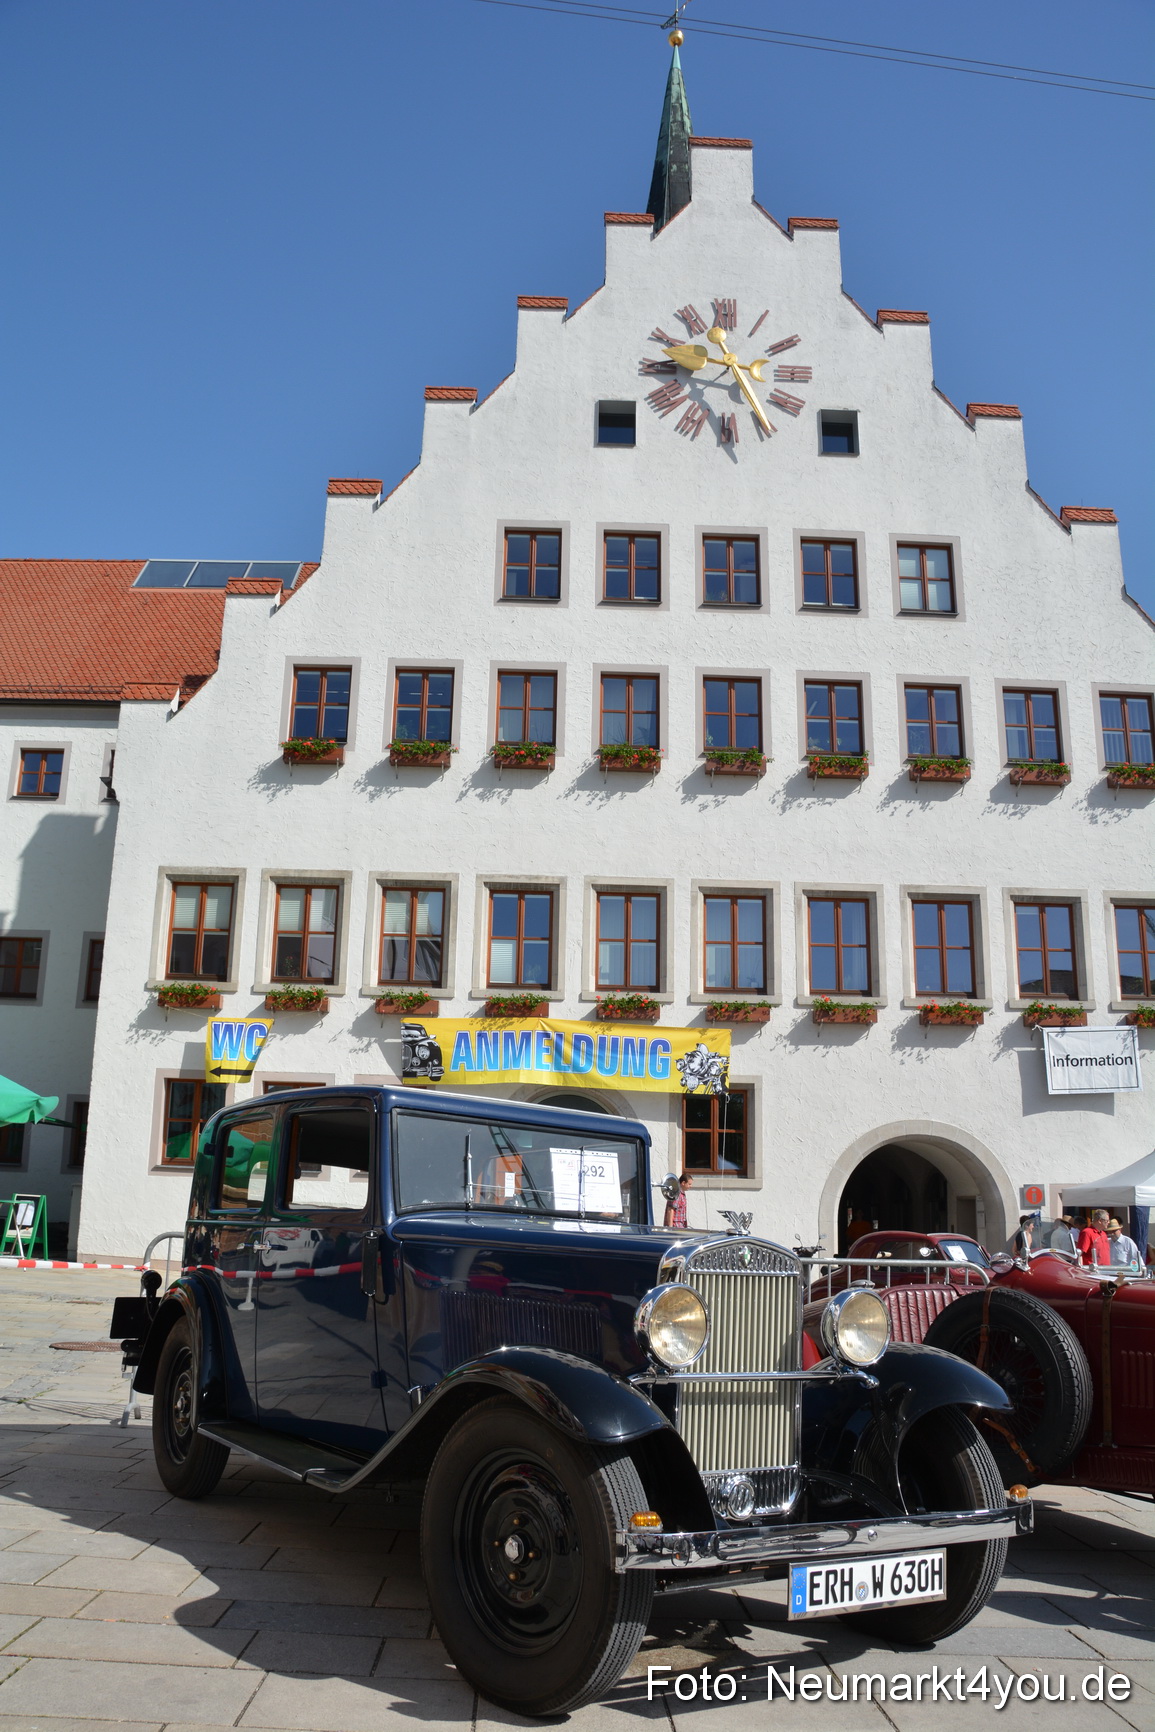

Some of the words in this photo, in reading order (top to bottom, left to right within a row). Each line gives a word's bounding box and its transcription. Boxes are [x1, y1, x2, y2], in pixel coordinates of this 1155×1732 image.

[212, 1021, 268, 1062] WC
[449, 1029, 672, 1080] ANMELDUNG
[1052, 1053, 1133, 1068] Information
[583, 1164, 606, 1178] 292
[809, 1567, 853, 1606] ERH
[871, 1564, 885, 1598] W
[890, 1557, 943, 1596] 630H
[795, 1594, 802, 1605] D
